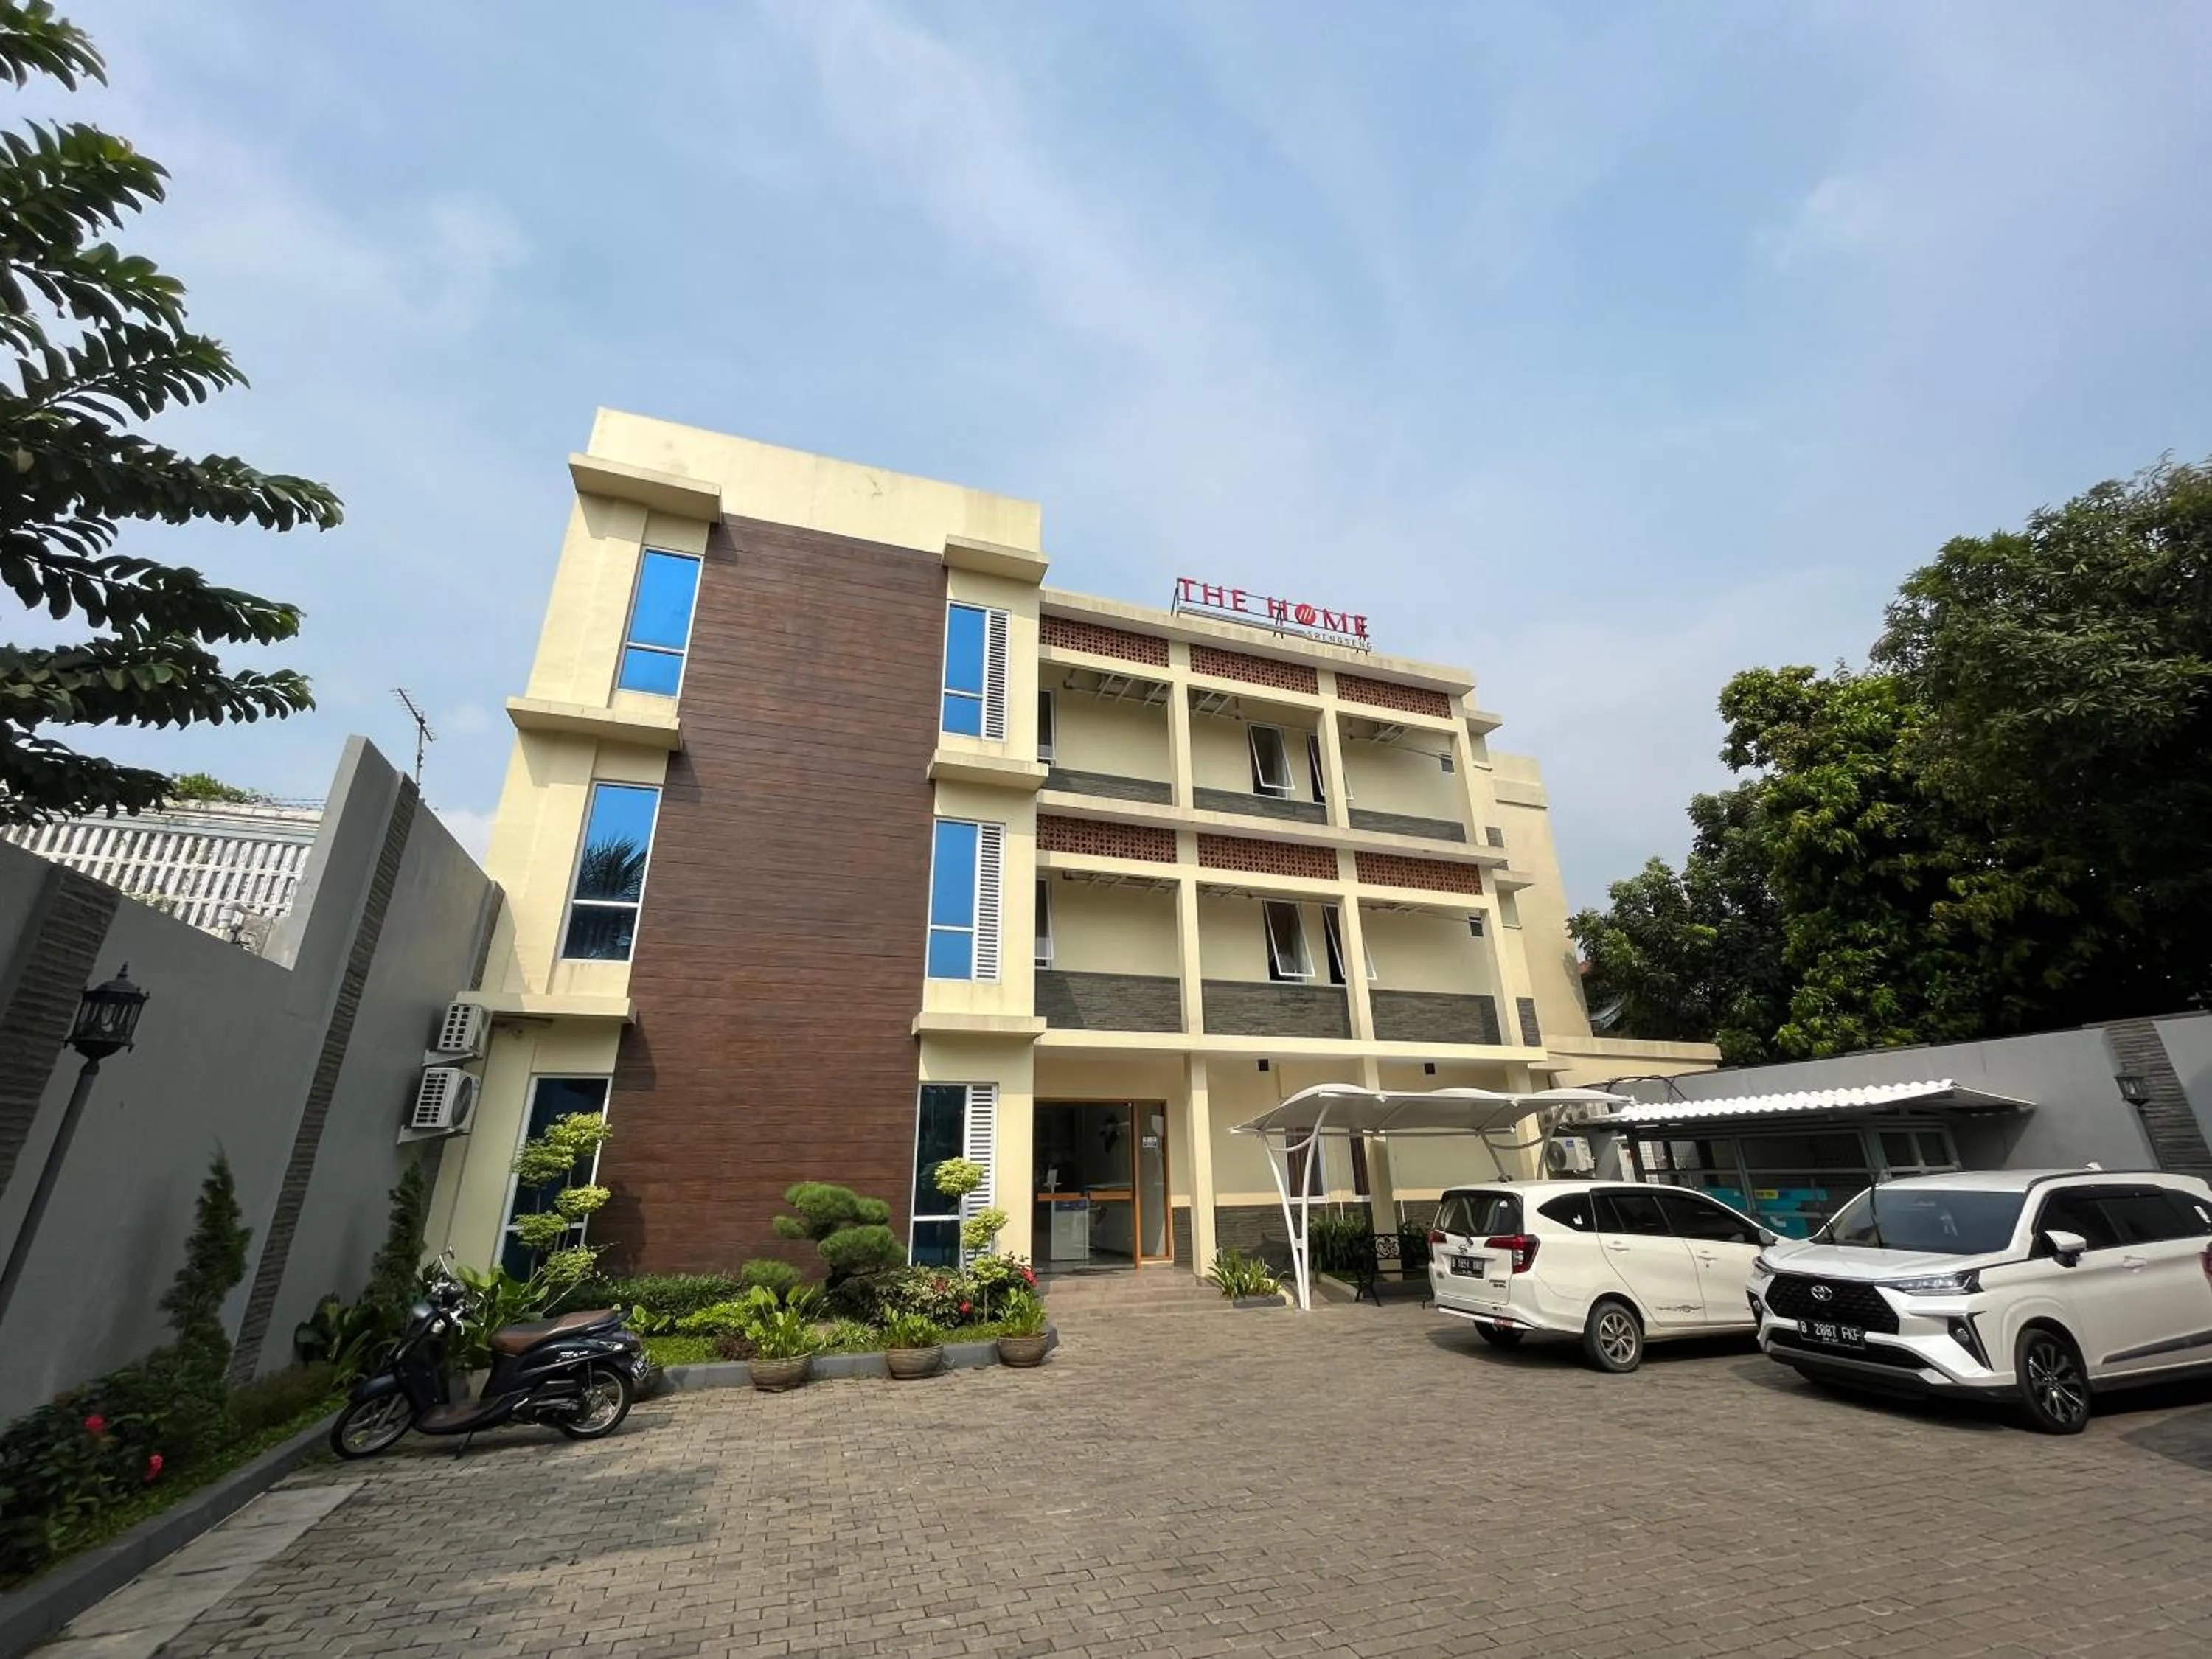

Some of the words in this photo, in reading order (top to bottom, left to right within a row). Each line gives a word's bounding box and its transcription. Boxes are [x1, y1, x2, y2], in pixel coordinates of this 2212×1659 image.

[1180, 578, 1248, 613] THE
[1267, 597, 1369, 638] HOME
[1307, 630, 1373, 651] SRENGSENG
[1800, 1321, 1807, 1334] B
